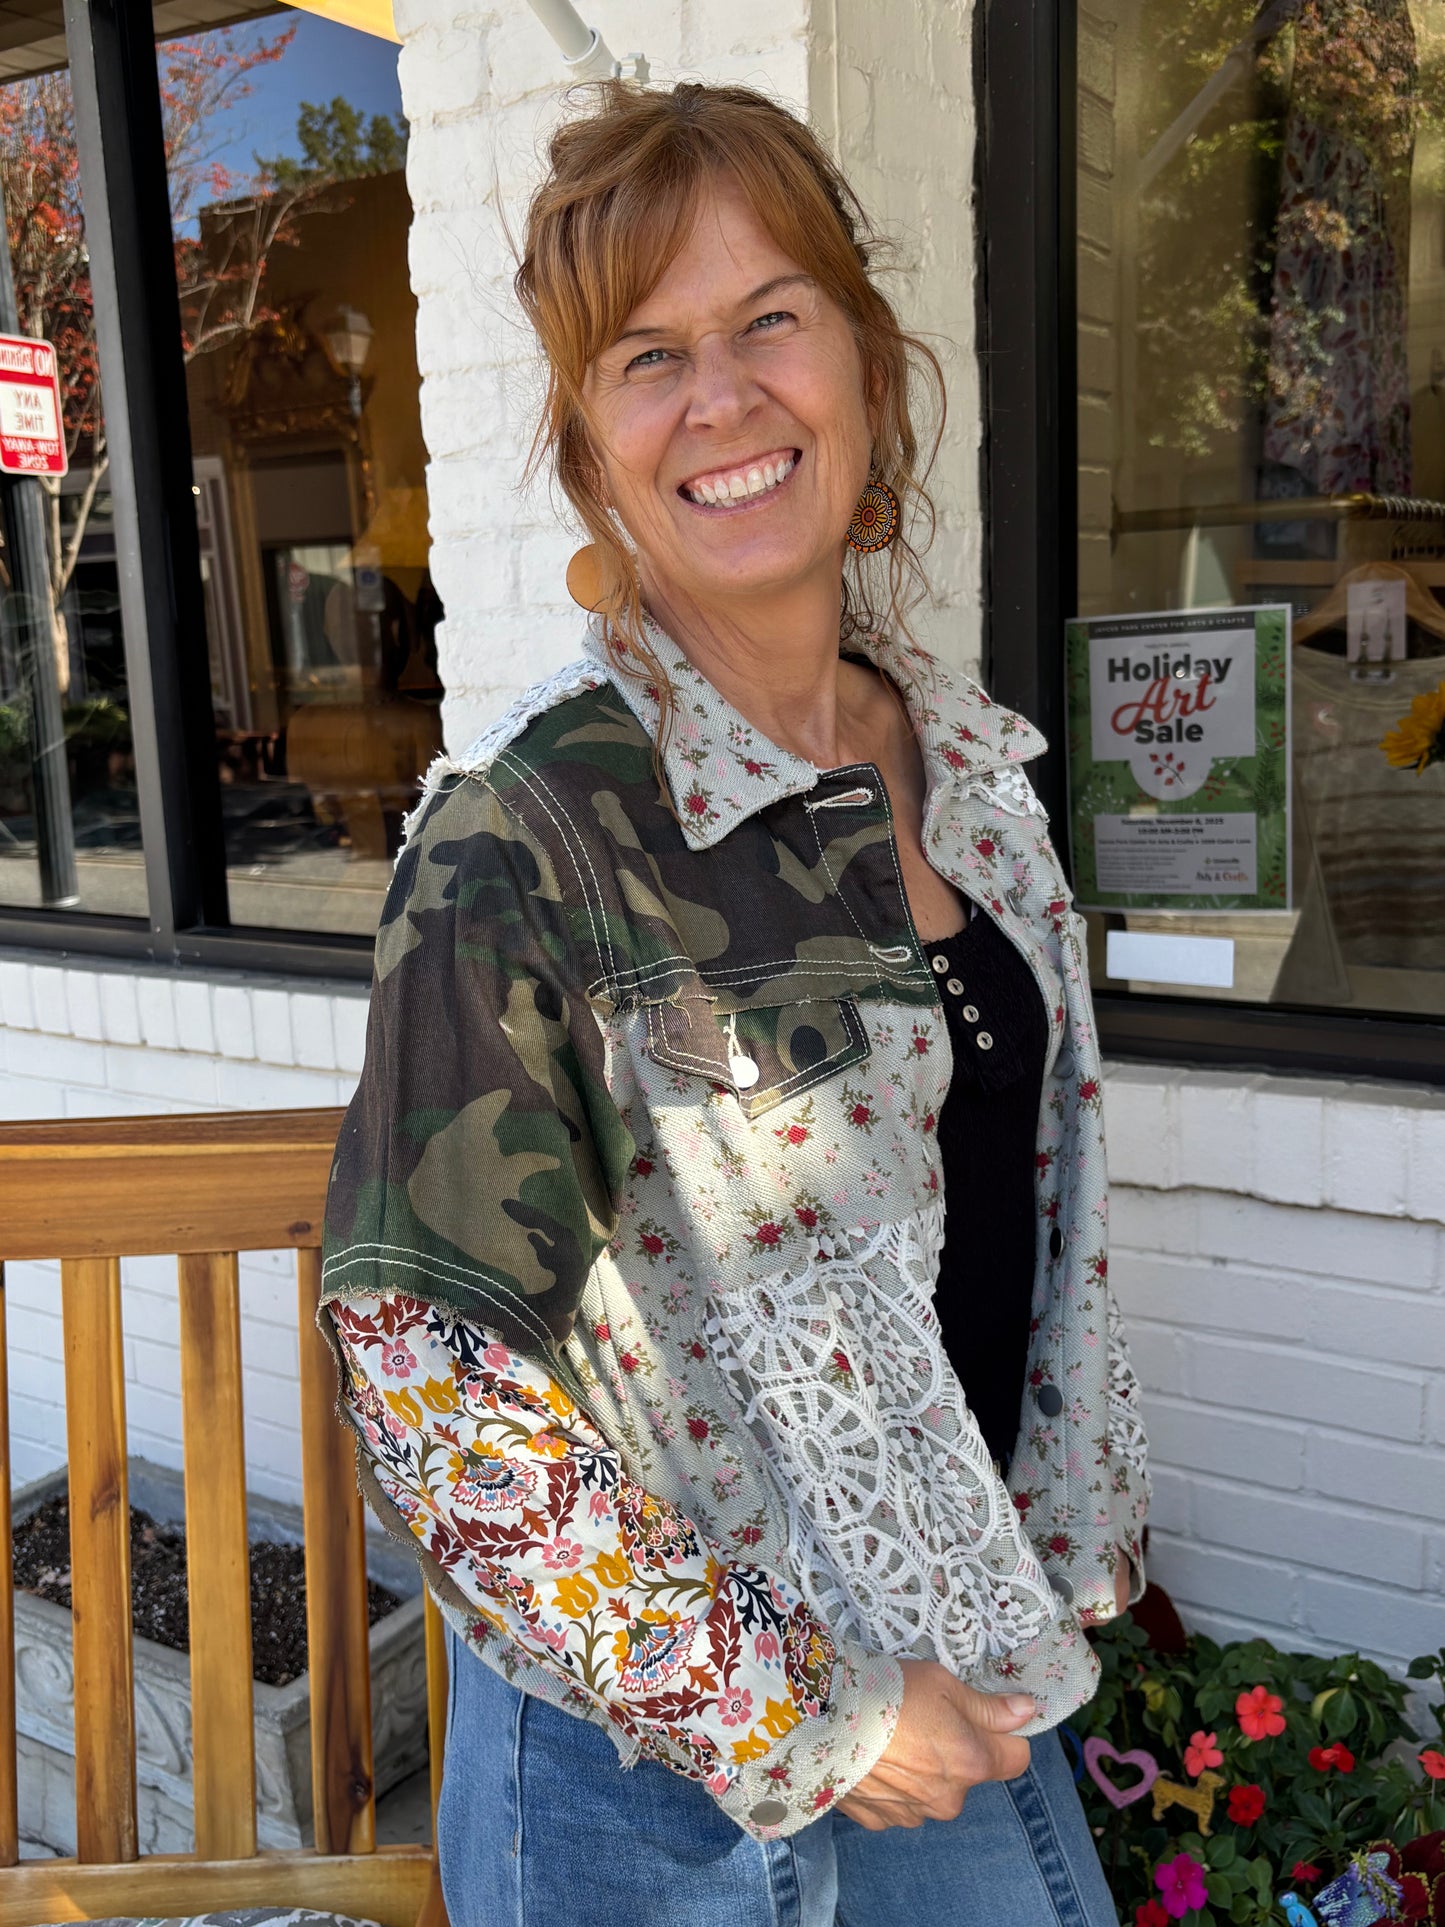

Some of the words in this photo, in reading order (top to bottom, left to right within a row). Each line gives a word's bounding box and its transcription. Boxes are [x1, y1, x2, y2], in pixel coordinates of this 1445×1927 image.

[1108, 653, 1233, 683] Holiday
[1111, 673, 1217, 735] Art
[1134, 718, 1204, 744] Sale
